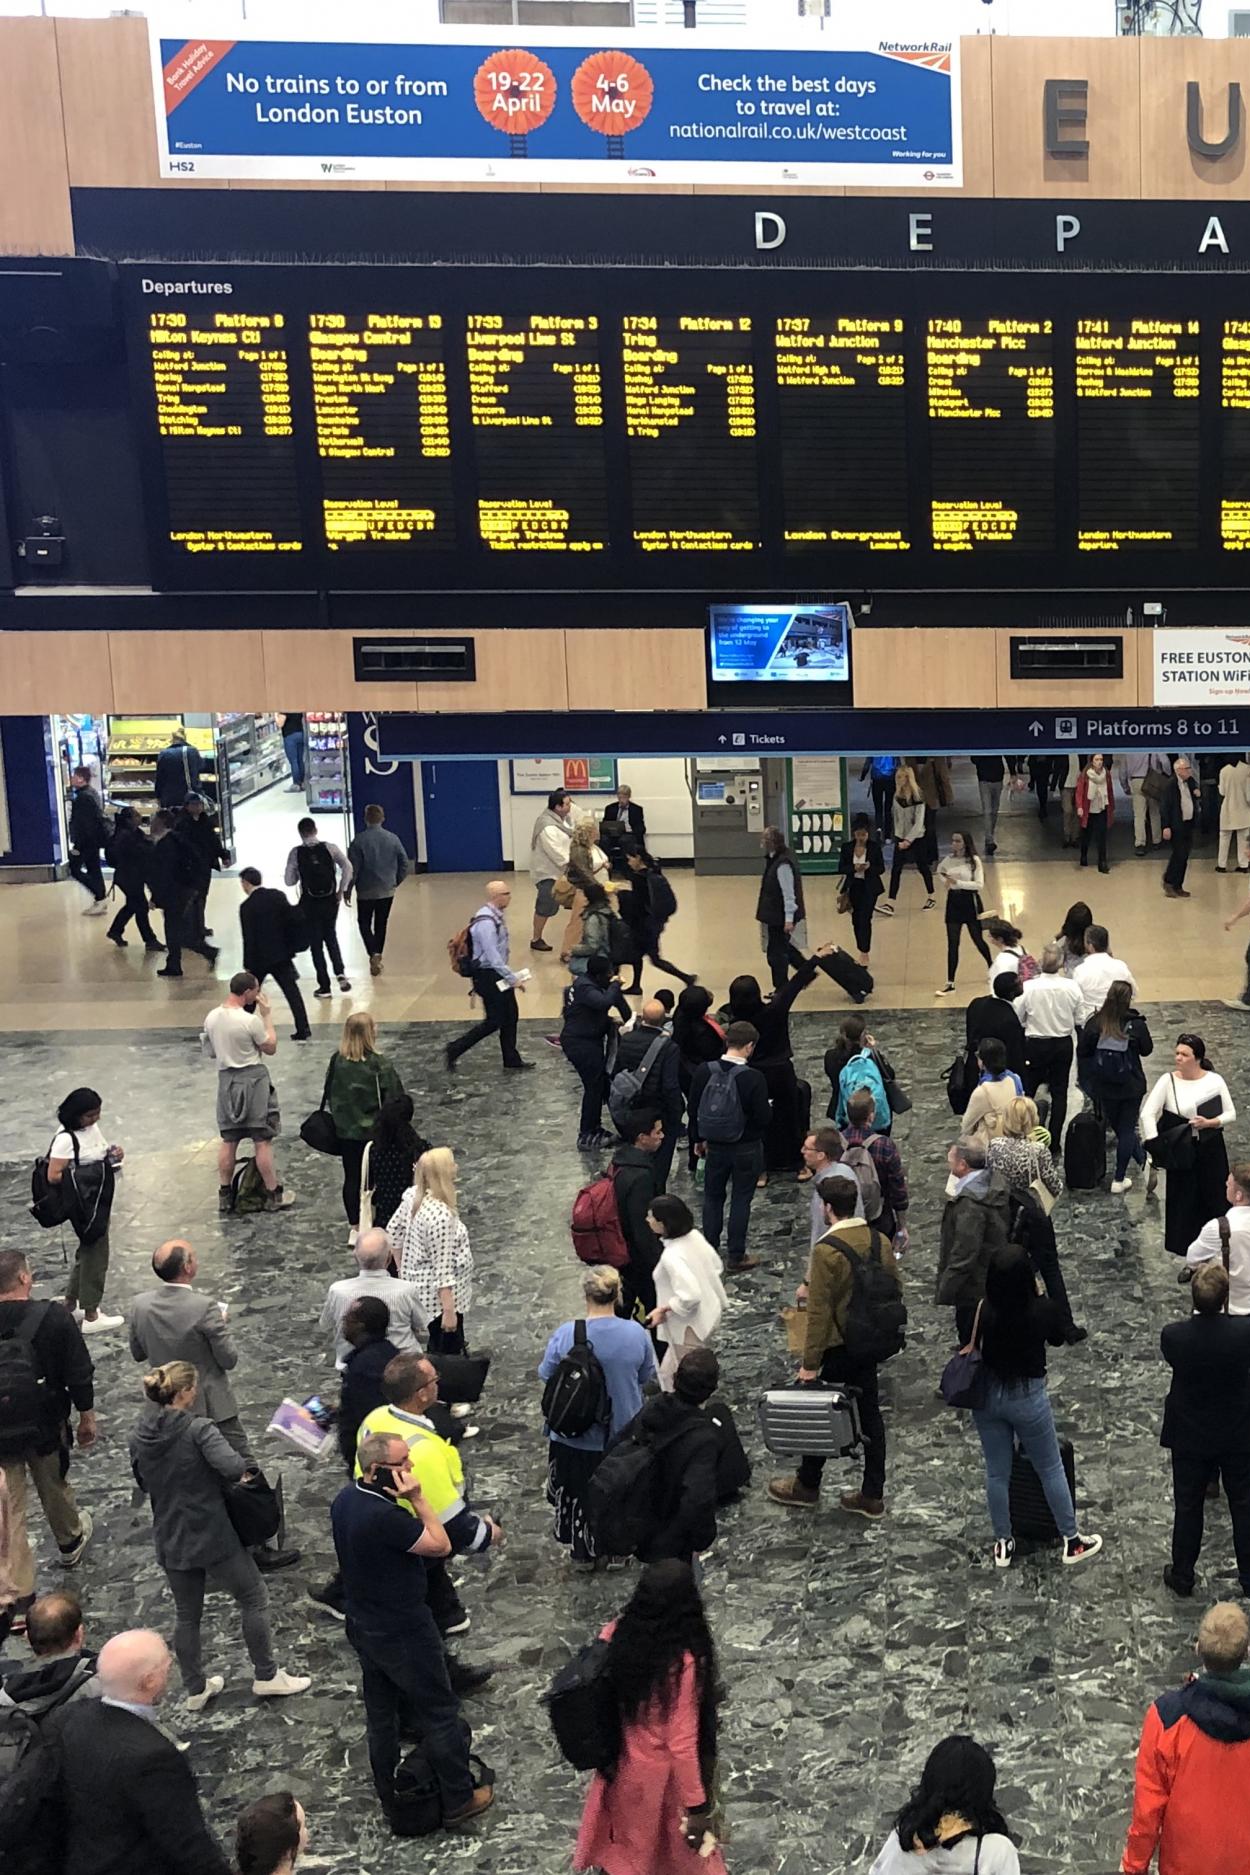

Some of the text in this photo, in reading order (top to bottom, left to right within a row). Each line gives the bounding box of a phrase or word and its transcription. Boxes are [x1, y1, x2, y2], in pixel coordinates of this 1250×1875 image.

[166, 43, 208, 86] Bank Holiday
[173, 50, 215, 91] Travel Advice
[226, 72, 448, 96] No trains to or from
[486, 71, 545, 91] 19-22
[595, 73, 630, 93] 4-6
[697, 74, 876, 98] Check the best days
[491, 94, 542, 114] April
[590, 95, 637, 118] May
[736, 99, 840, 117] to travel at:
[255, 103, 423, 125] London Euston
[669, 123, 908, 142] nationalrail.co.uk/westcoast
[175, 141, 202, 149] #Euston
[891, 150, 947, 161] Working for you
[169, 161, 195, 172] HS2
[141, 279, 233, 296] Departures
[151, 313, 270, 327] 17:30 Platform
[468, 315, 597, 329] 17:33 Platform 3
[624, 317, 751, 330] 17:34 Platform 12
[777, 318, 890, 332] 17:37 Platform
[929, 320, 1052, 333] 17:40 Platform 2
[1078, 320, 1199, 334] 17:41 Platform 14
[467, 332, 576, 346] Liverpool Lime St
[623, 333, 657, 350] Tring
[776, 335, 879, 348] Watford Junction
[927, 336, 1026, 349] Manchester Picc
[1076, 336, 1176, 350] Watford Junction
[927, 352, 980, 368] Boarding
[736, 617, 765, 625] changing
[765, 617, 779, 625] your
[730, 632, 769, 640] underground
[1161, 652, 1194, 664] FREE
[1162, 670, 1220, 682] STATION
[1086, 719, 1240, 738] Platforms 8 to 11
[749, 732, 786, 746] Tickets
